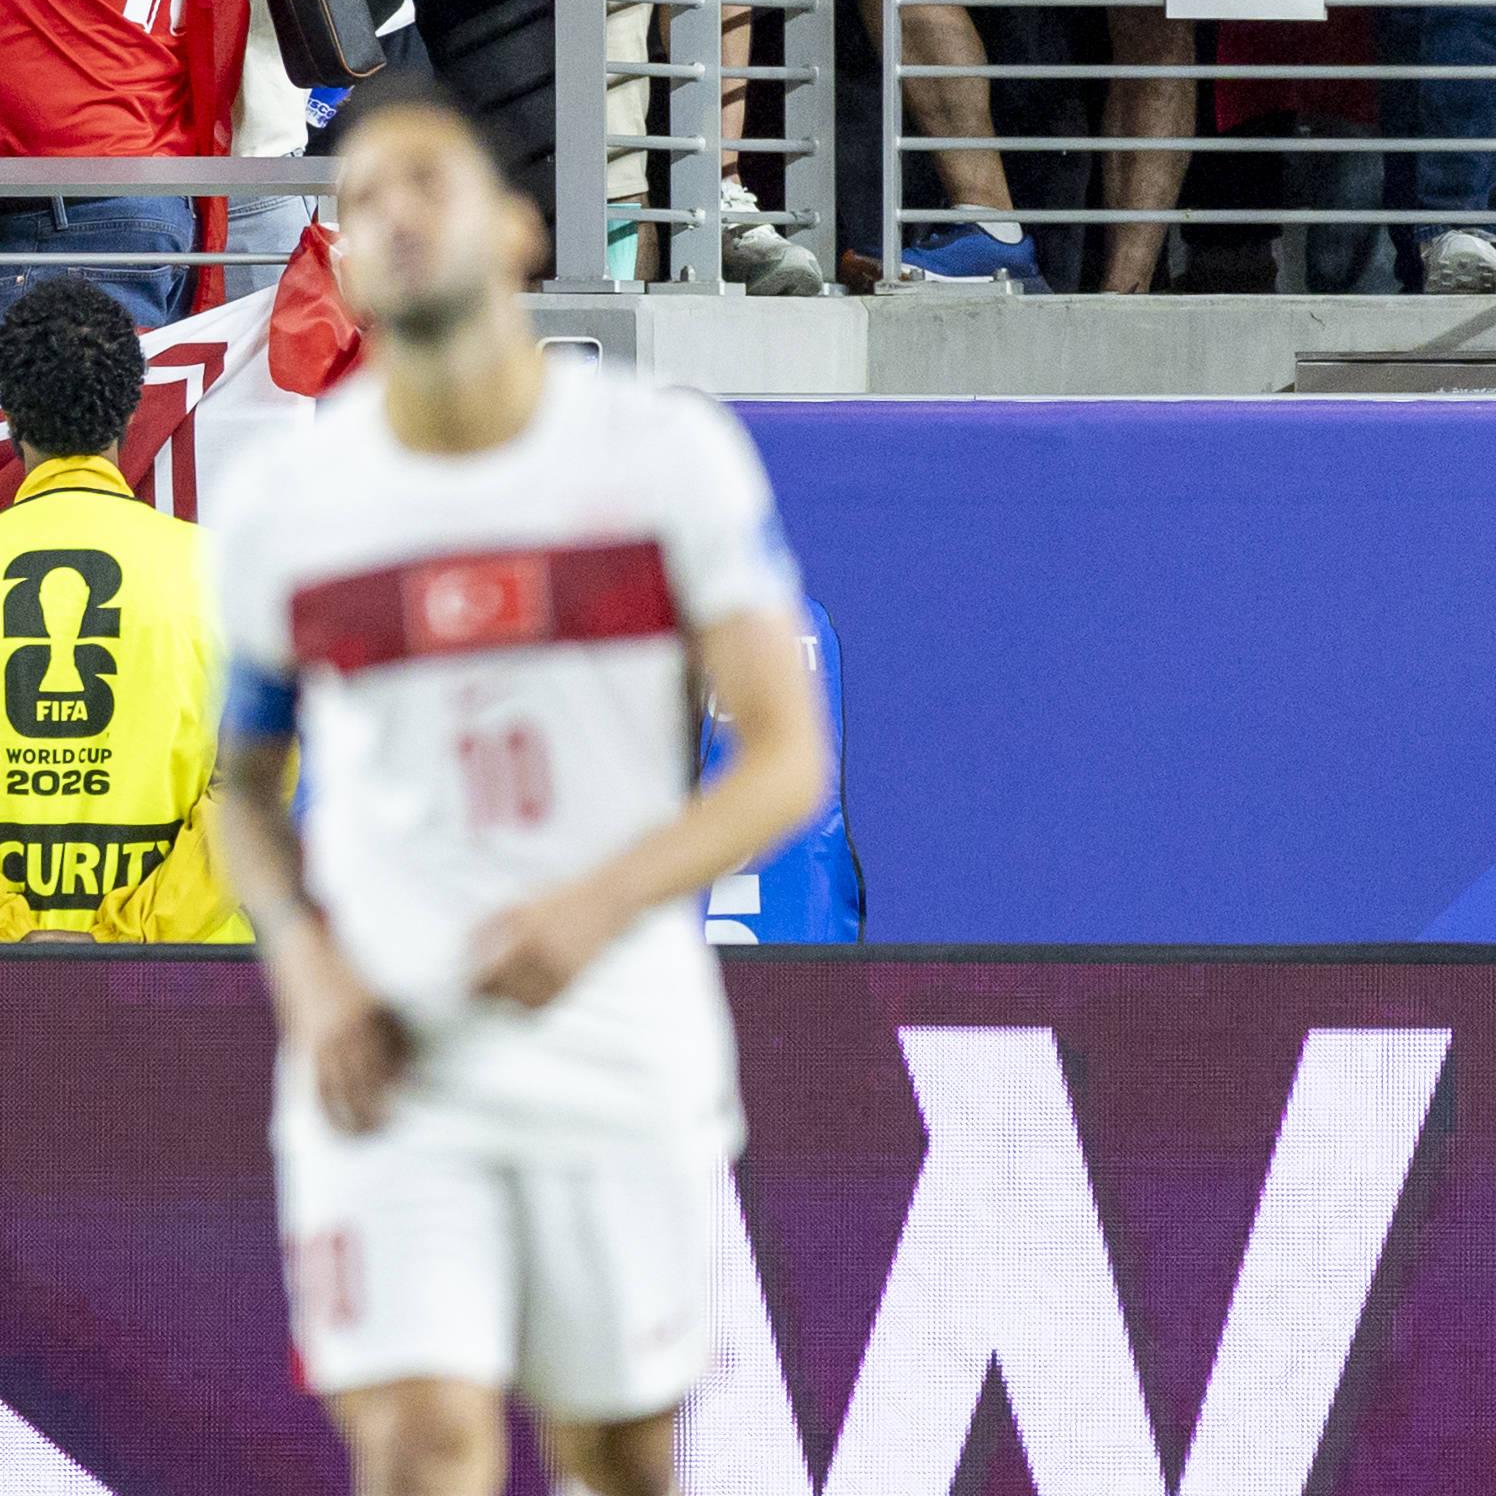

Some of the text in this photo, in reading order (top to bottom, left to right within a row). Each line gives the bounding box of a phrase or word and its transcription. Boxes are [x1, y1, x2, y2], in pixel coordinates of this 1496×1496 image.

[35, 699, 89, 722] FIFA
[6, 748, 113, 765] WORLD CUP
[6, 769, 111, 796] 2026
